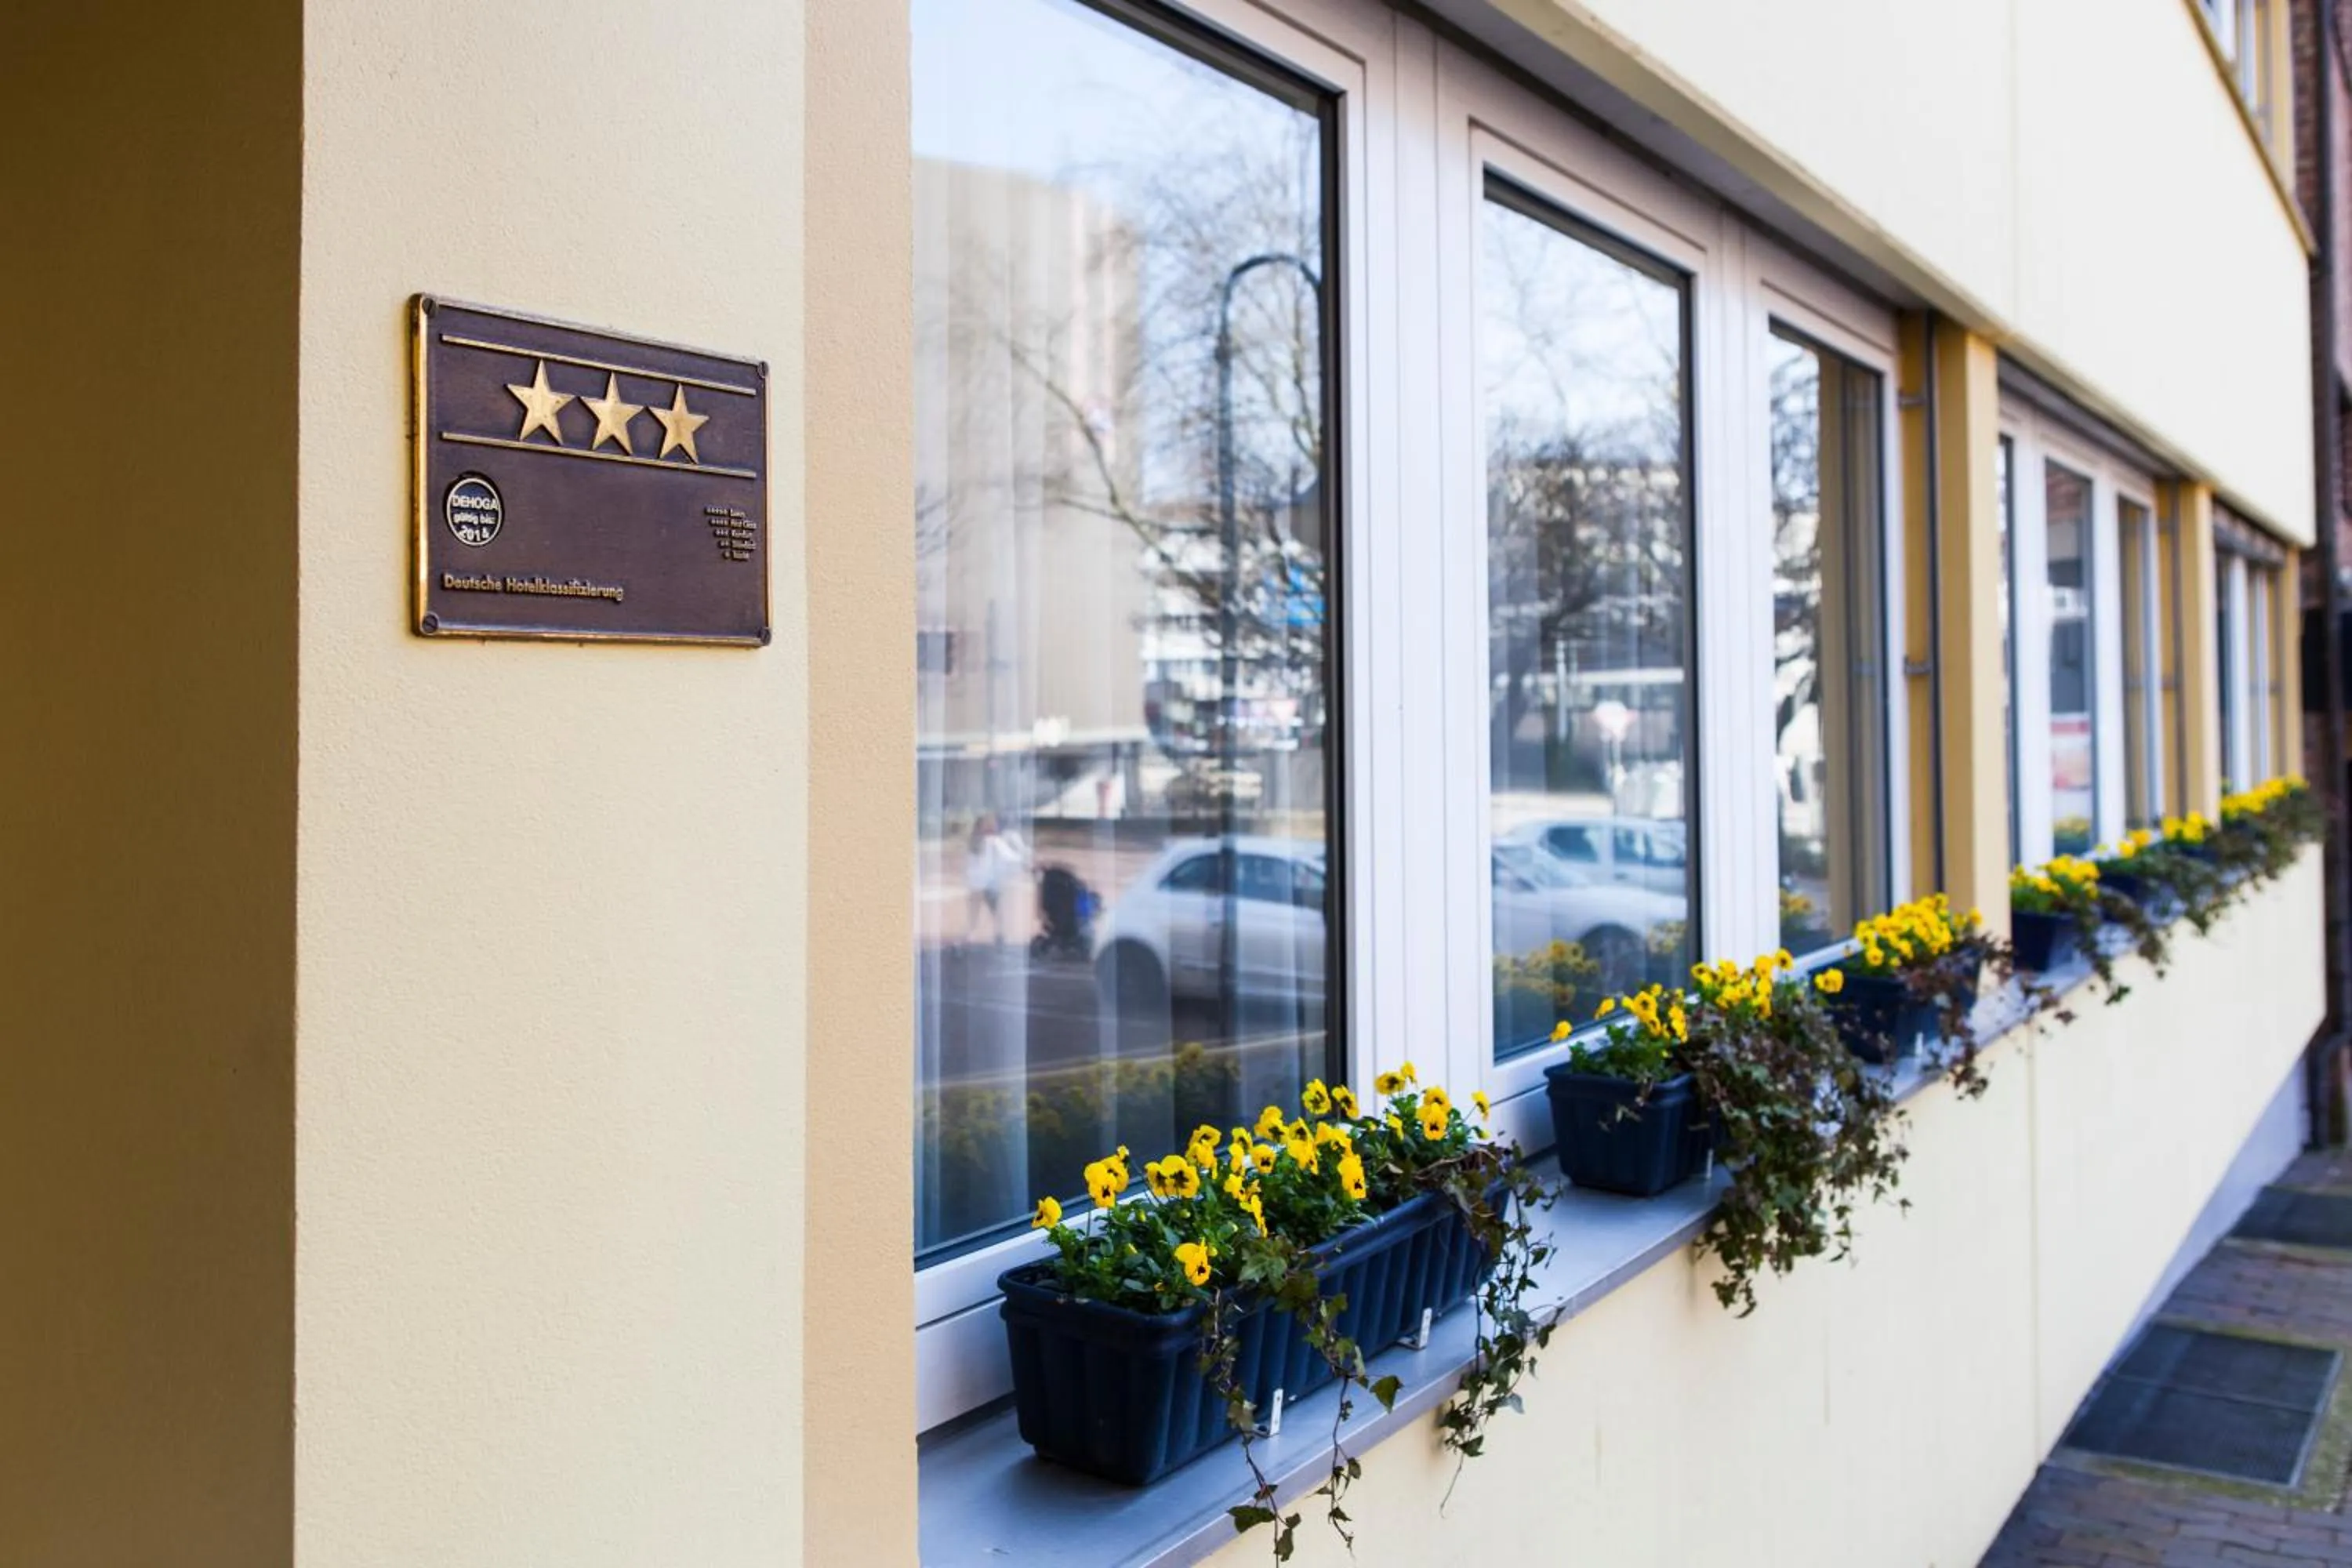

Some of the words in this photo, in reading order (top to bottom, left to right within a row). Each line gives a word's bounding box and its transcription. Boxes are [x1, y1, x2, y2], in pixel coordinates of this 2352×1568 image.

[452, 495, 499, 510] DEHOGA
[458, 524, 490, 541] 2014
[444, 572, 502, 591] Deutsche
[506, 576, 623, 601] Hotelklassifizierung
